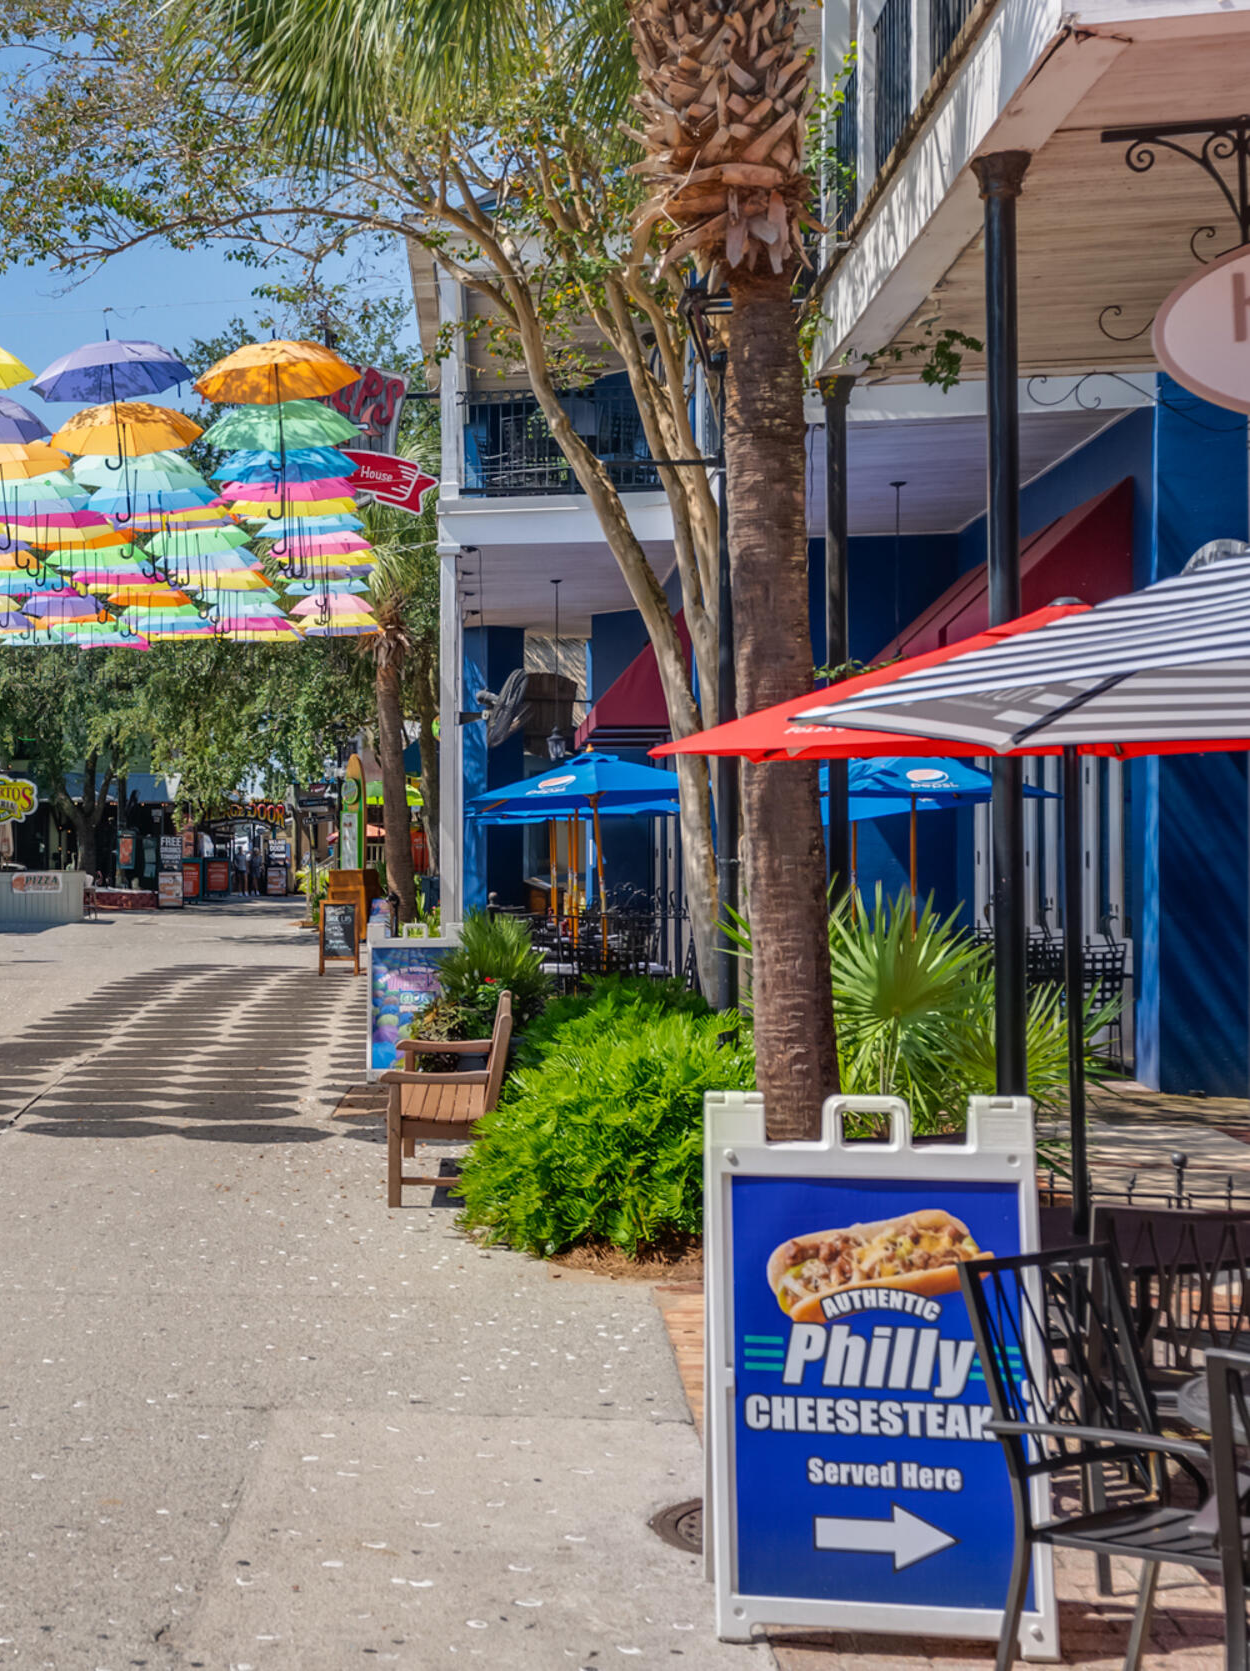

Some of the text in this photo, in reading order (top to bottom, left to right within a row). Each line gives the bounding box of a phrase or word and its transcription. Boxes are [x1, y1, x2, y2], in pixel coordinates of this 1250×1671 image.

[360, 465, 393, 482] House
[248, 803, 286, 829] DOOR
[160, 836, 183, 847] FREE
[24, 875, 59, 885] PIZZA
[821, 1287, 942, 1322] AUTHENTIC
[782, 1322, 977, 1399] Philly
[744, 1394, 999, 1442] CHEESESTEAK
[807, 1456, 964, 1492] Served Here
